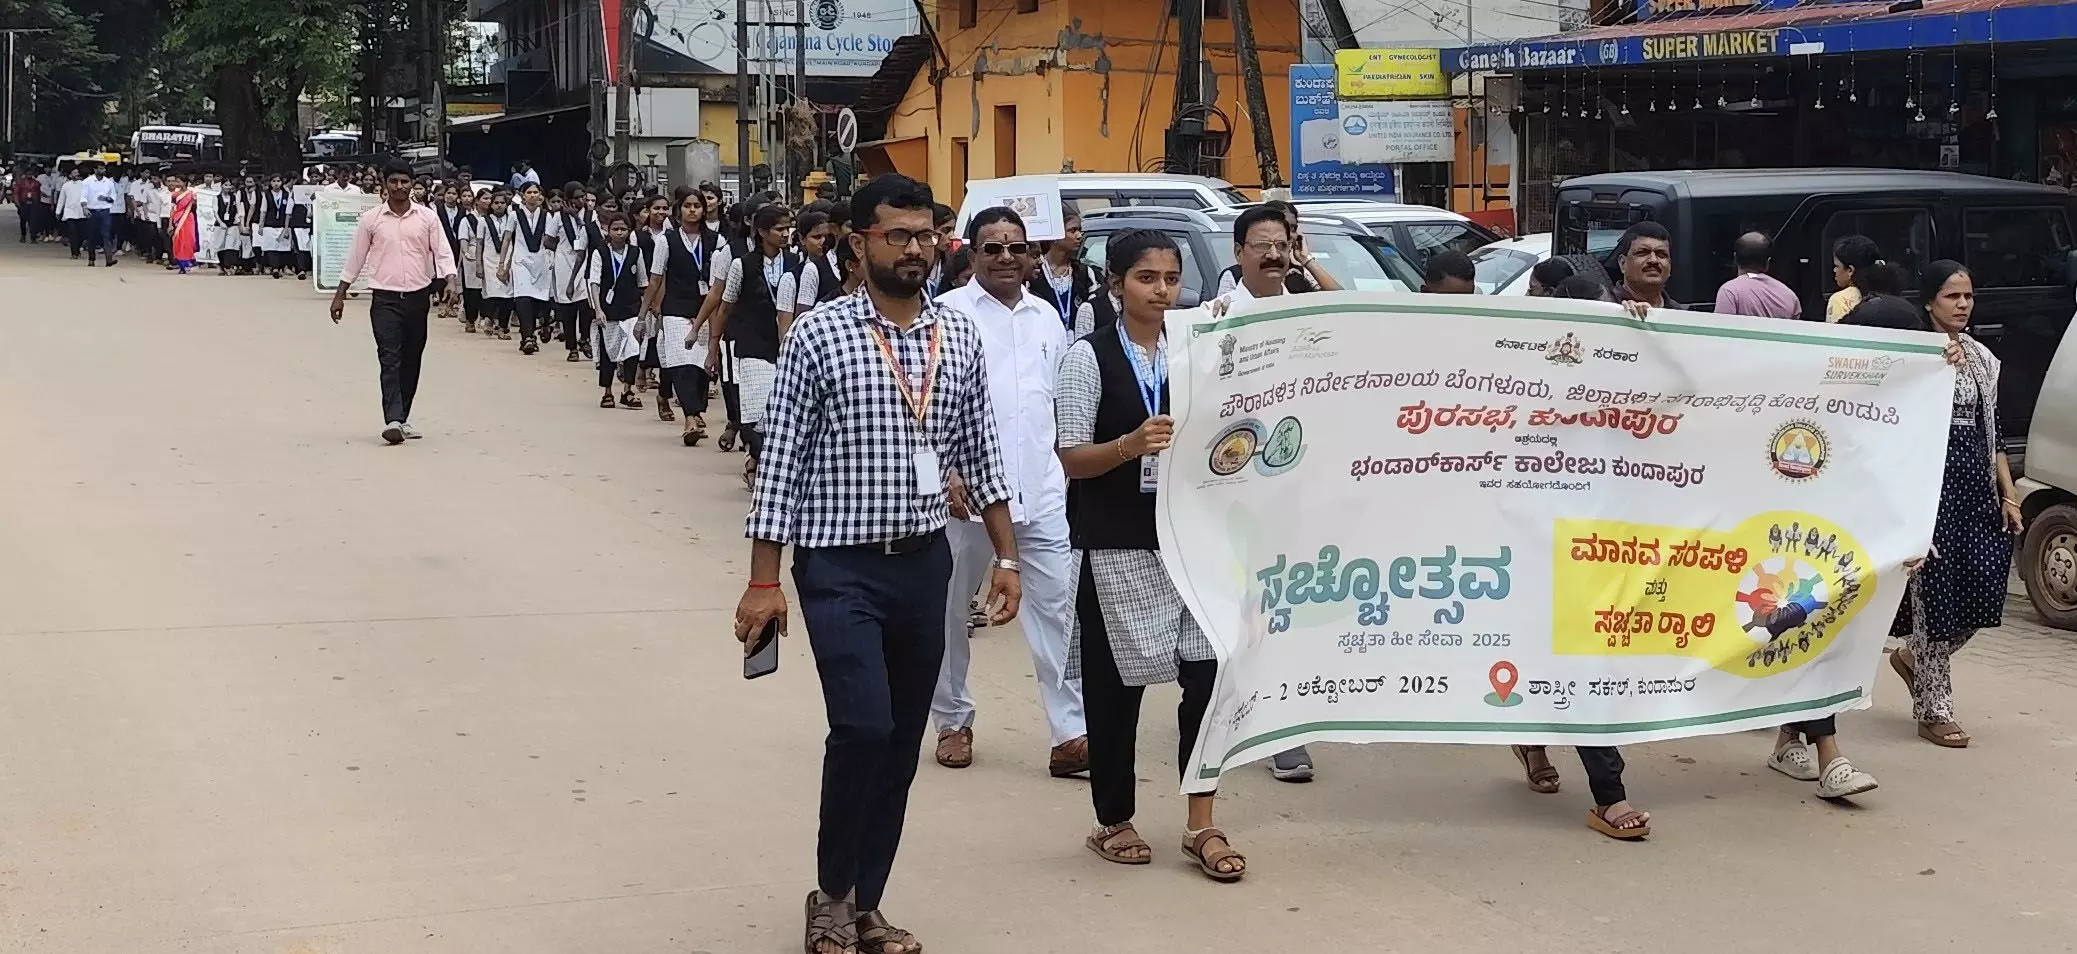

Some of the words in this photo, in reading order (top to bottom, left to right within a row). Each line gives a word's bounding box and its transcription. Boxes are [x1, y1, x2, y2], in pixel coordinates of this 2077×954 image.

[826, 33, 863, 56] Cycle
[1520, 46, 1576, 68] Bazaar
[1643, 35, 1699, 60] SUPER
[1703, 31, 1779, 57] MARKET
[141, 132, 197, 142] BHARATHI
[1414, 143, 1438, 151] OFFICE
[1495, 337, 1548, 352] ಕರ್ನಾಟಕ
[1593, 347, 1639, 363] ಸರಕಾರ
[1823, 370, 1888, 380] SURVEKSHAN
[1827, 356, 1870, 370] SWACHH
[1219, 377, 1297, 418] ಪೌರಾಡಳಿತ
[1300, 368, 1440, 397] ನಿರ್ದೇಶನಾಲಯ
[1826, 396, 1901, 427] ಉಡುಪಿ
[1514, 450, 1606, 475] ಕಾಲೇಜು
[1611, 455, 1706, 488] ಕುಂದಾಪುರ
[1571, 532, 1662, 566] ಮಾನವ
[1668, 539, 1748, 574] ಸರಪಳಿ
[1644, 578, 1668, 603] ಮತ್ತು
[1418, 629, 1463, 647] ಸೇವಾ
[1472, 633, 1511, 647] 2025
[1279, 682, 1288, 701] 2
[1297, 675, 1387, 703] ಅಕ್ಟೋಬರ್
[1399, 675, 1449, 694] 2025
[1637, 675, 1697, 695] ಕುಂದಾಪುರ
